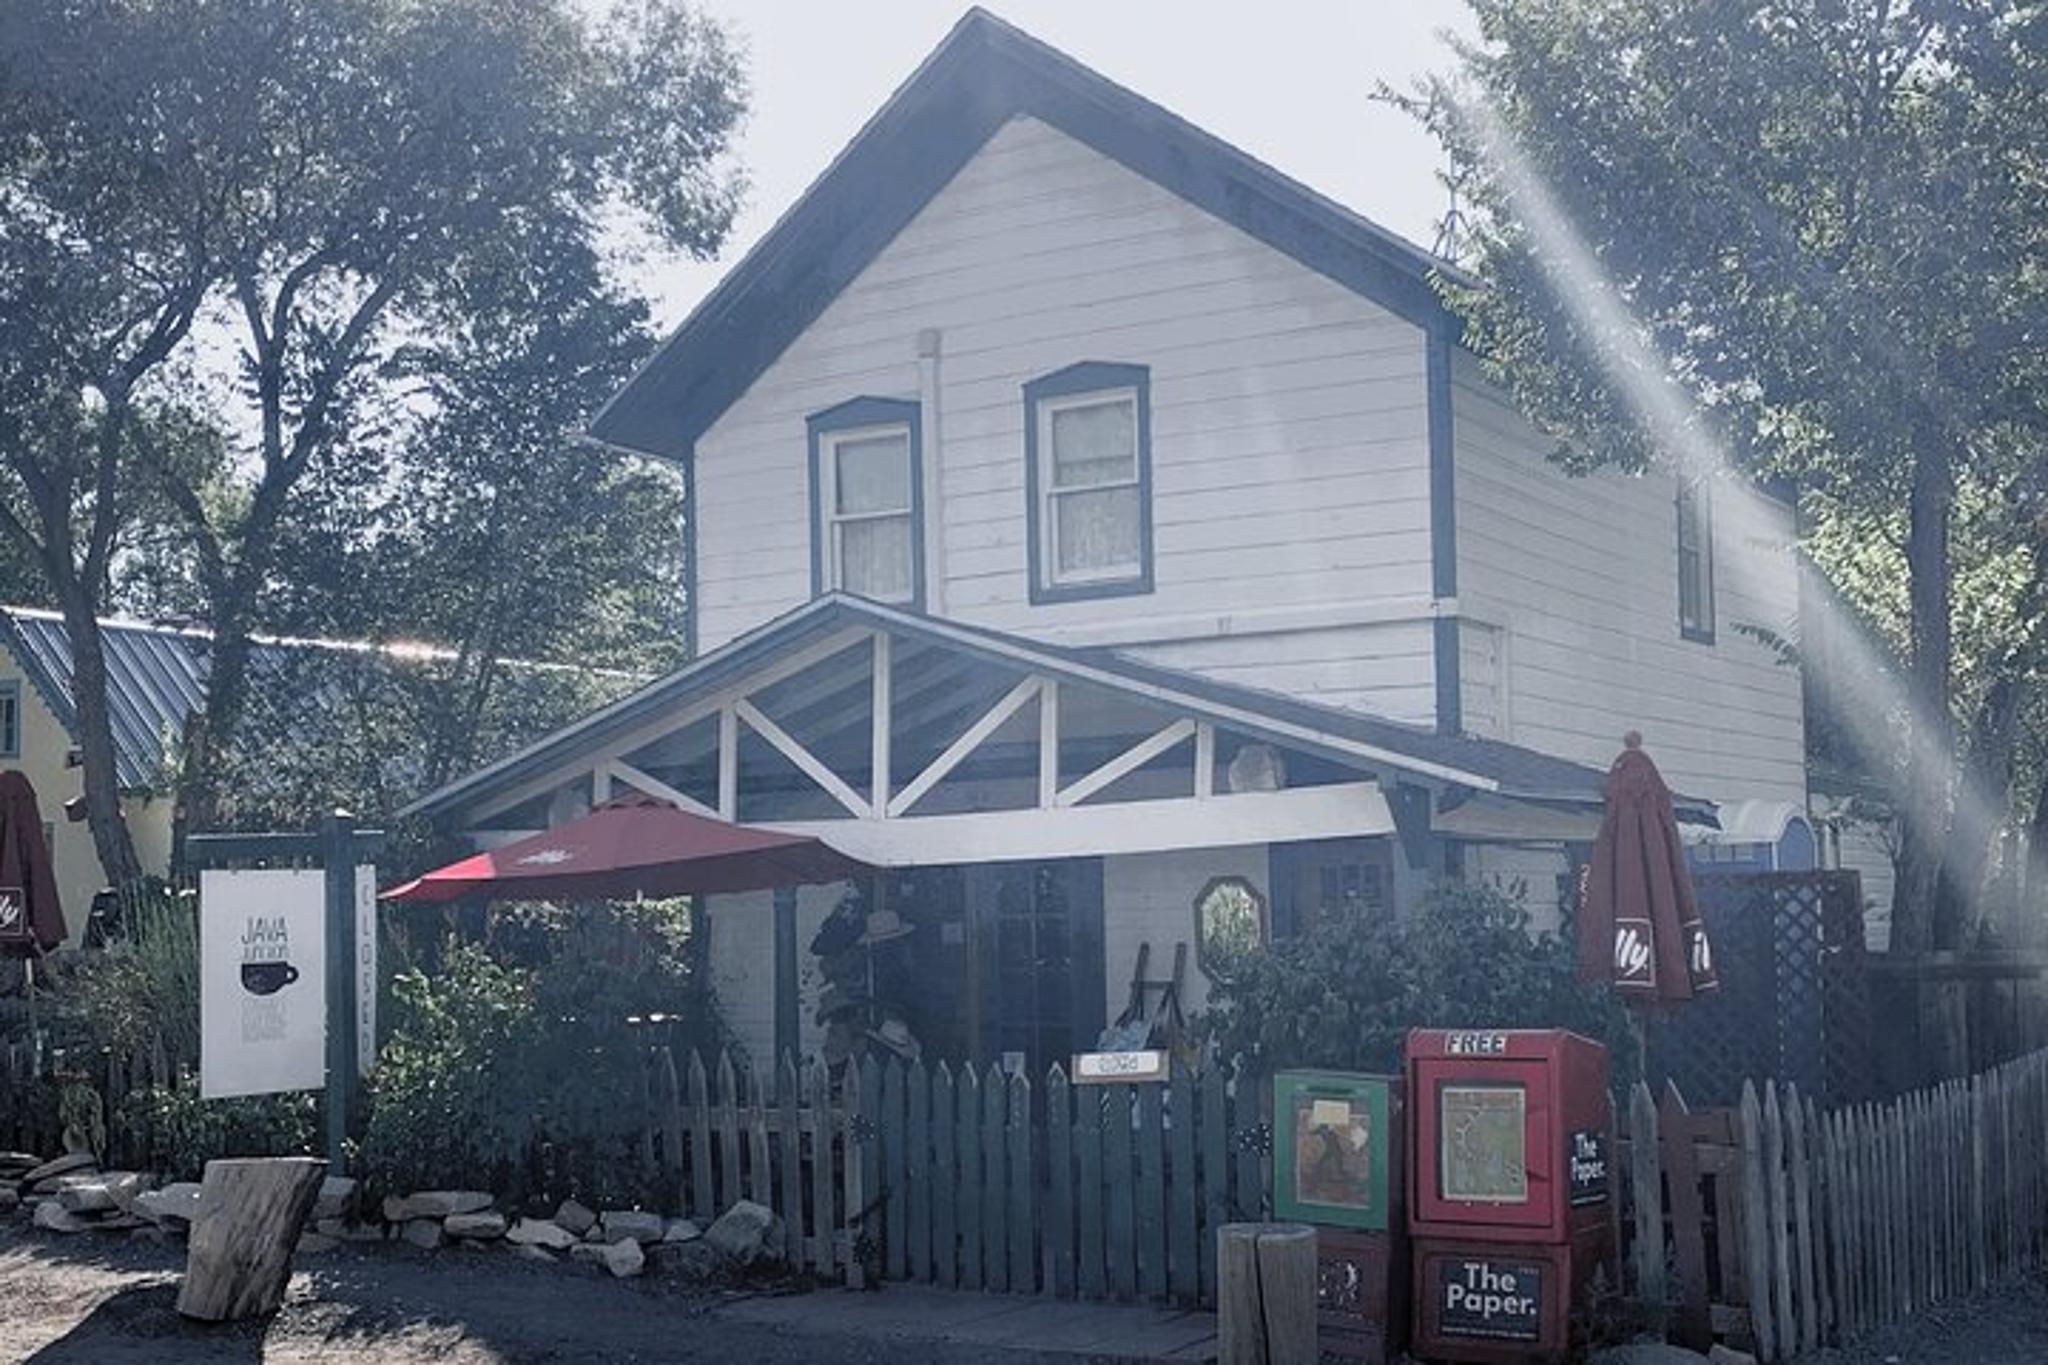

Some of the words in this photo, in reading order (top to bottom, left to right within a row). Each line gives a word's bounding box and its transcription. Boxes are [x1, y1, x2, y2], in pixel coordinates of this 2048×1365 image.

[241, 916, 288, 944] JAVA
[1447, 1033, 1506, 1053] FREE
[1575, 1133, 1598, 1158] The
[1463, 1262, 1517, 1292] The
[1447, 1283, 1537, 1320] Paper.
